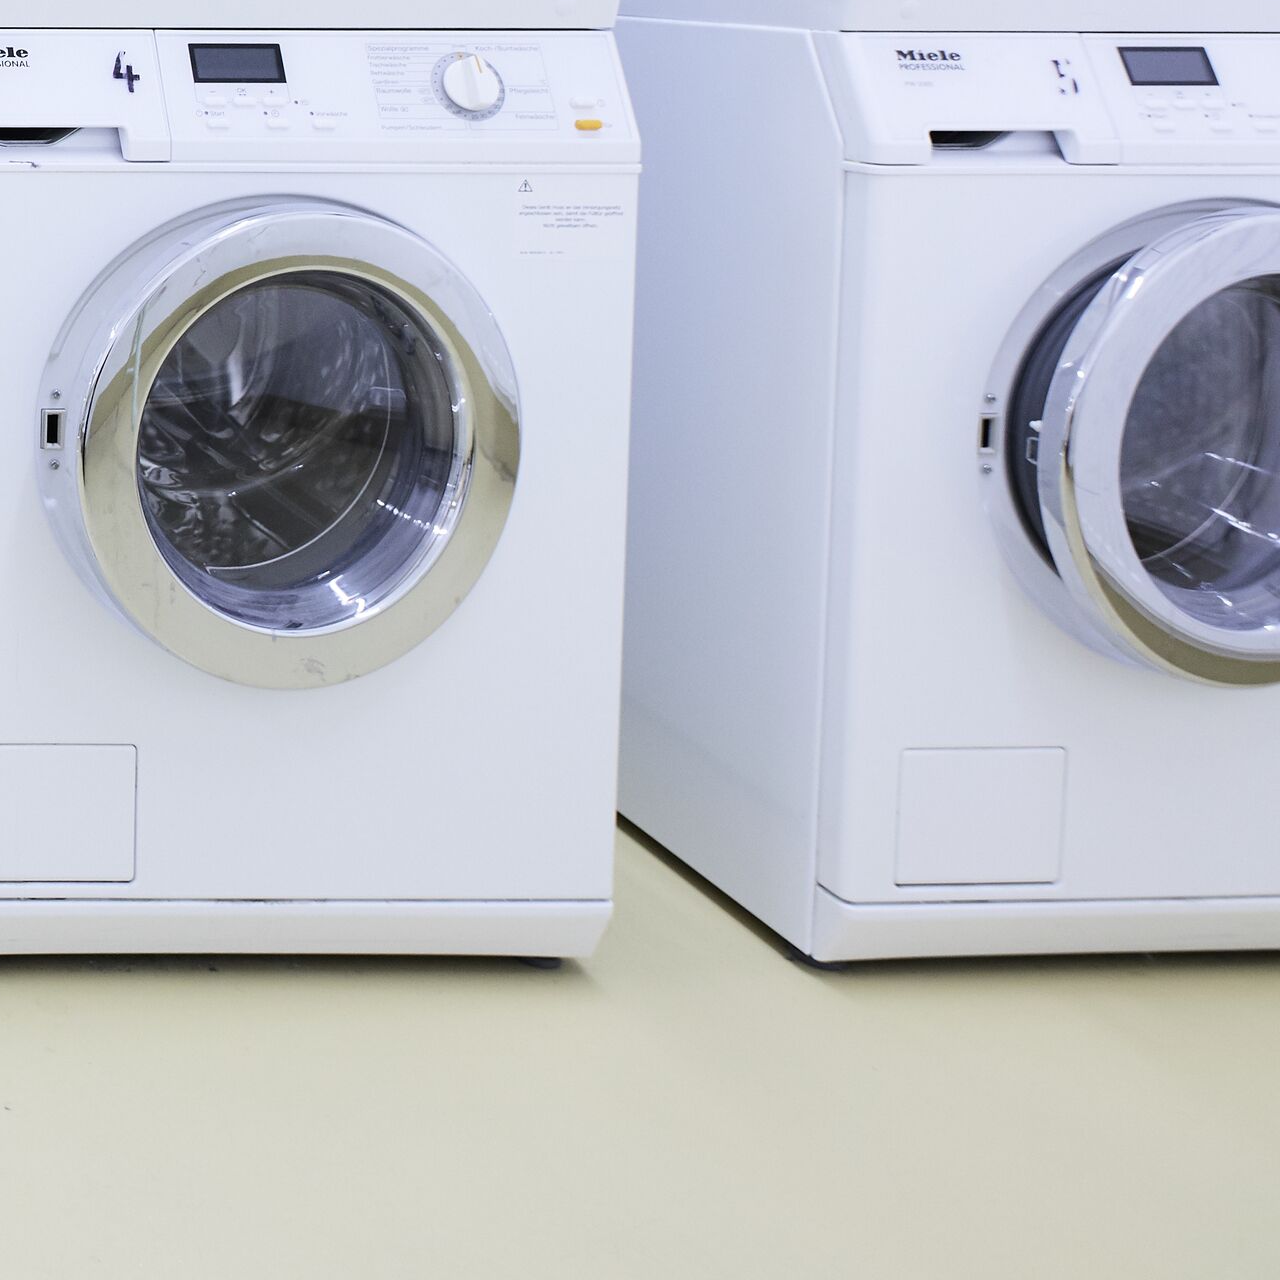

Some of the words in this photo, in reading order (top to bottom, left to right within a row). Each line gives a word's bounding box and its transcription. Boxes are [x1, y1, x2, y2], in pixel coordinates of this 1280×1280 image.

[895, 50, 961, 61] Miele
[112, 51, 141, 94] 4
[898, 63, 965, 71] PROFESSIONAL
